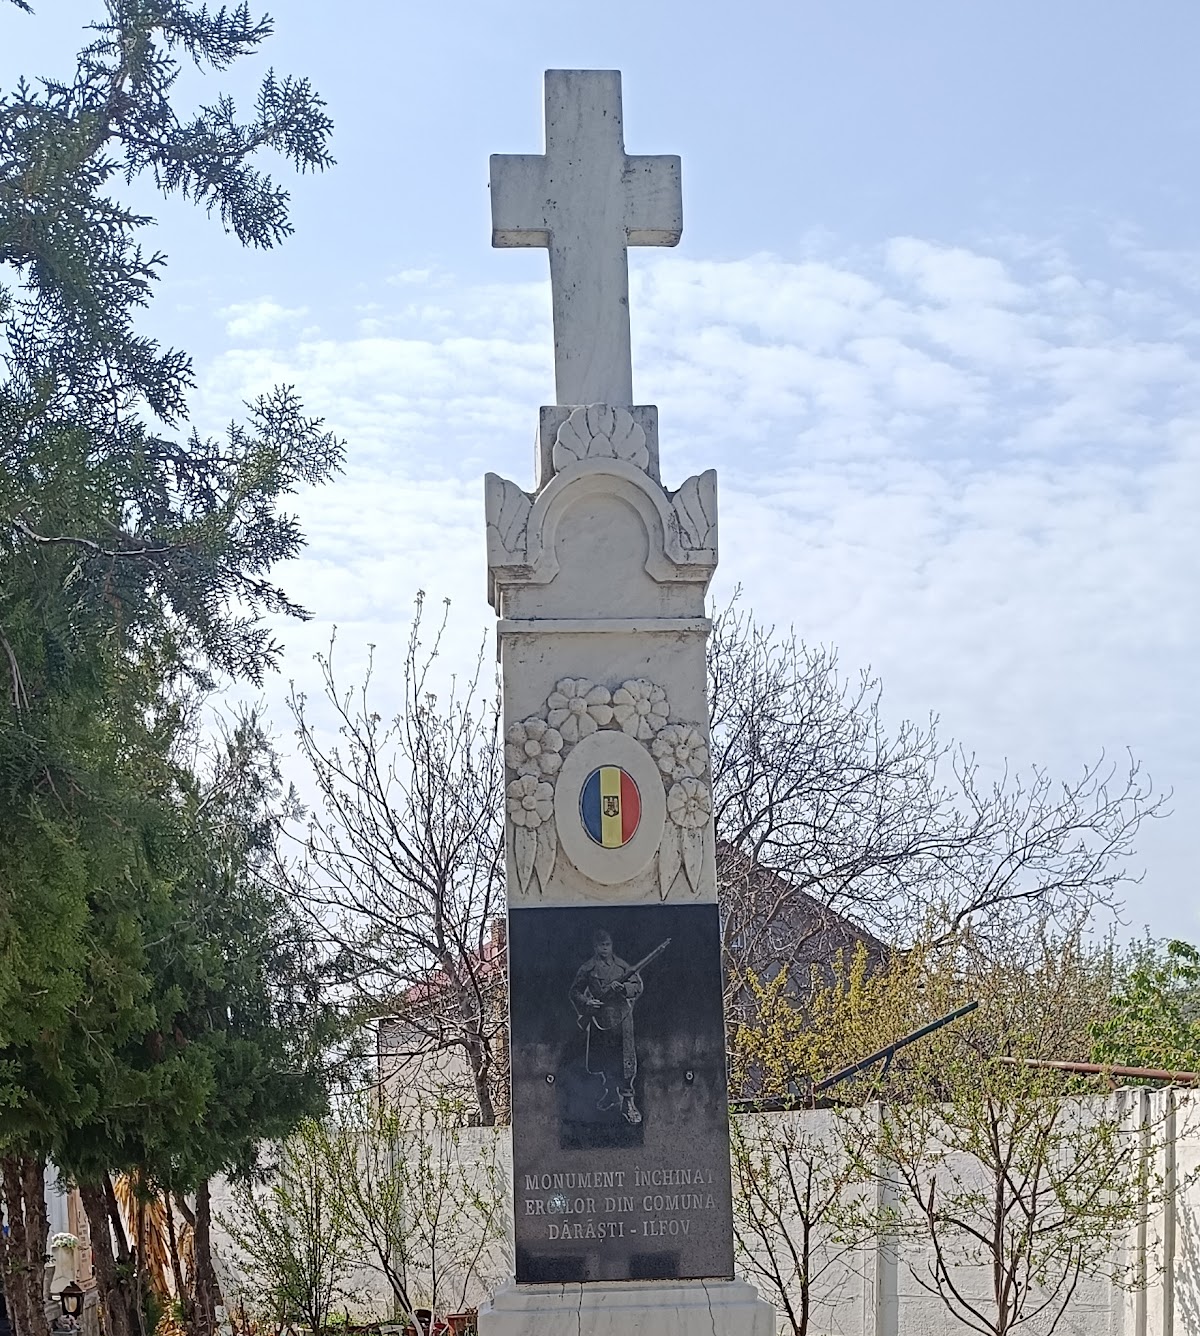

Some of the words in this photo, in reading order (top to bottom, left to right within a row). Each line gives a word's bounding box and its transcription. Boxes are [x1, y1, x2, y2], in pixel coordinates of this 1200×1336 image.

[524, 1171, 625, 1190] MONUMENT
[634, 1166, 714, 1187] ÎNCHINAT
[604, 1196, 634, 1213] DIN
[643, 1193, 716, 1212] COMUNA
[643, 1219, 691, 1236] ILFOV
